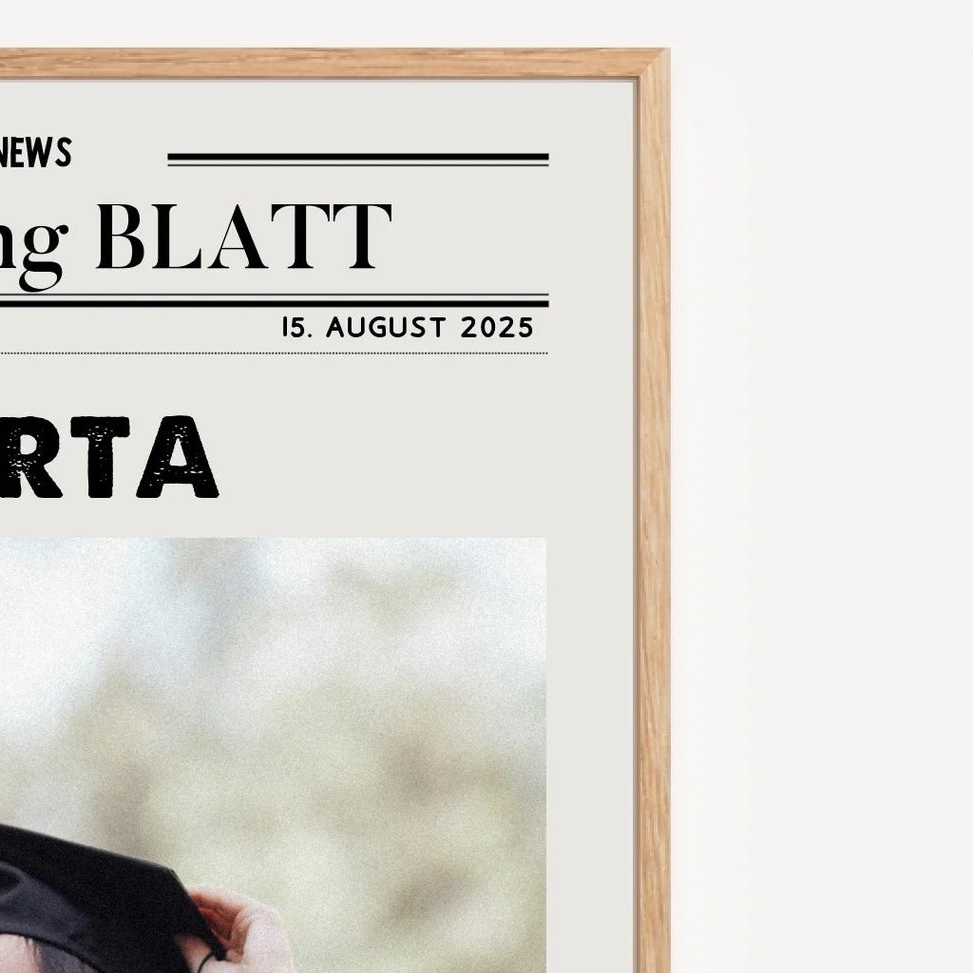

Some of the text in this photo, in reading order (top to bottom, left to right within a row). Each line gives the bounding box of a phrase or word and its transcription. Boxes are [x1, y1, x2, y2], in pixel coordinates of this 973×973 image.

[95, 203, 392, 269] BLATT
[282, 315, 533, 338] 15. AUGUST 2025
